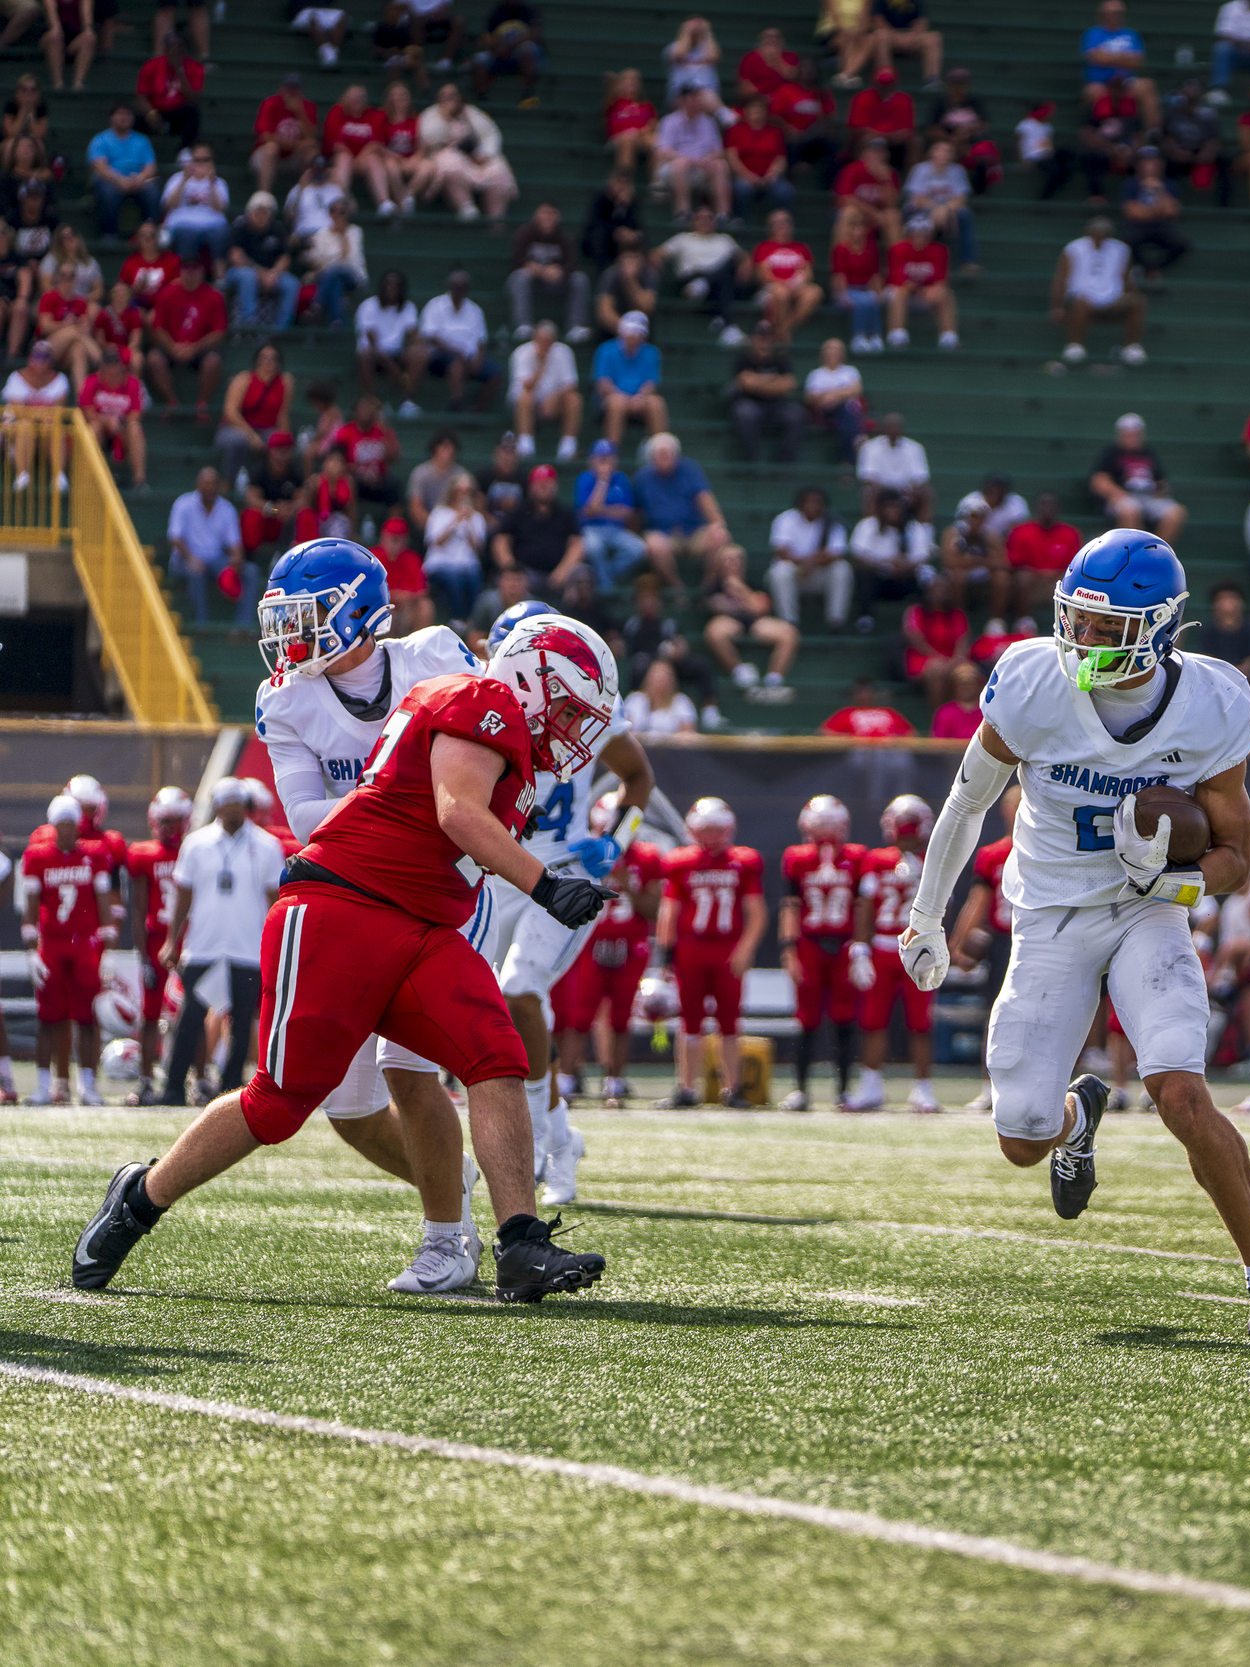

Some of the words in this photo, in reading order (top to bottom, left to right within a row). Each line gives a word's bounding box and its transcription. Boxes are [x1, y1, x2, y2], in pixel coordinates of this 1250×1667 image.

[1076, 589, 1105, 602] Riddell
[328, 757, 370, 781] SHA
[57, 884, 78, 923] 7
